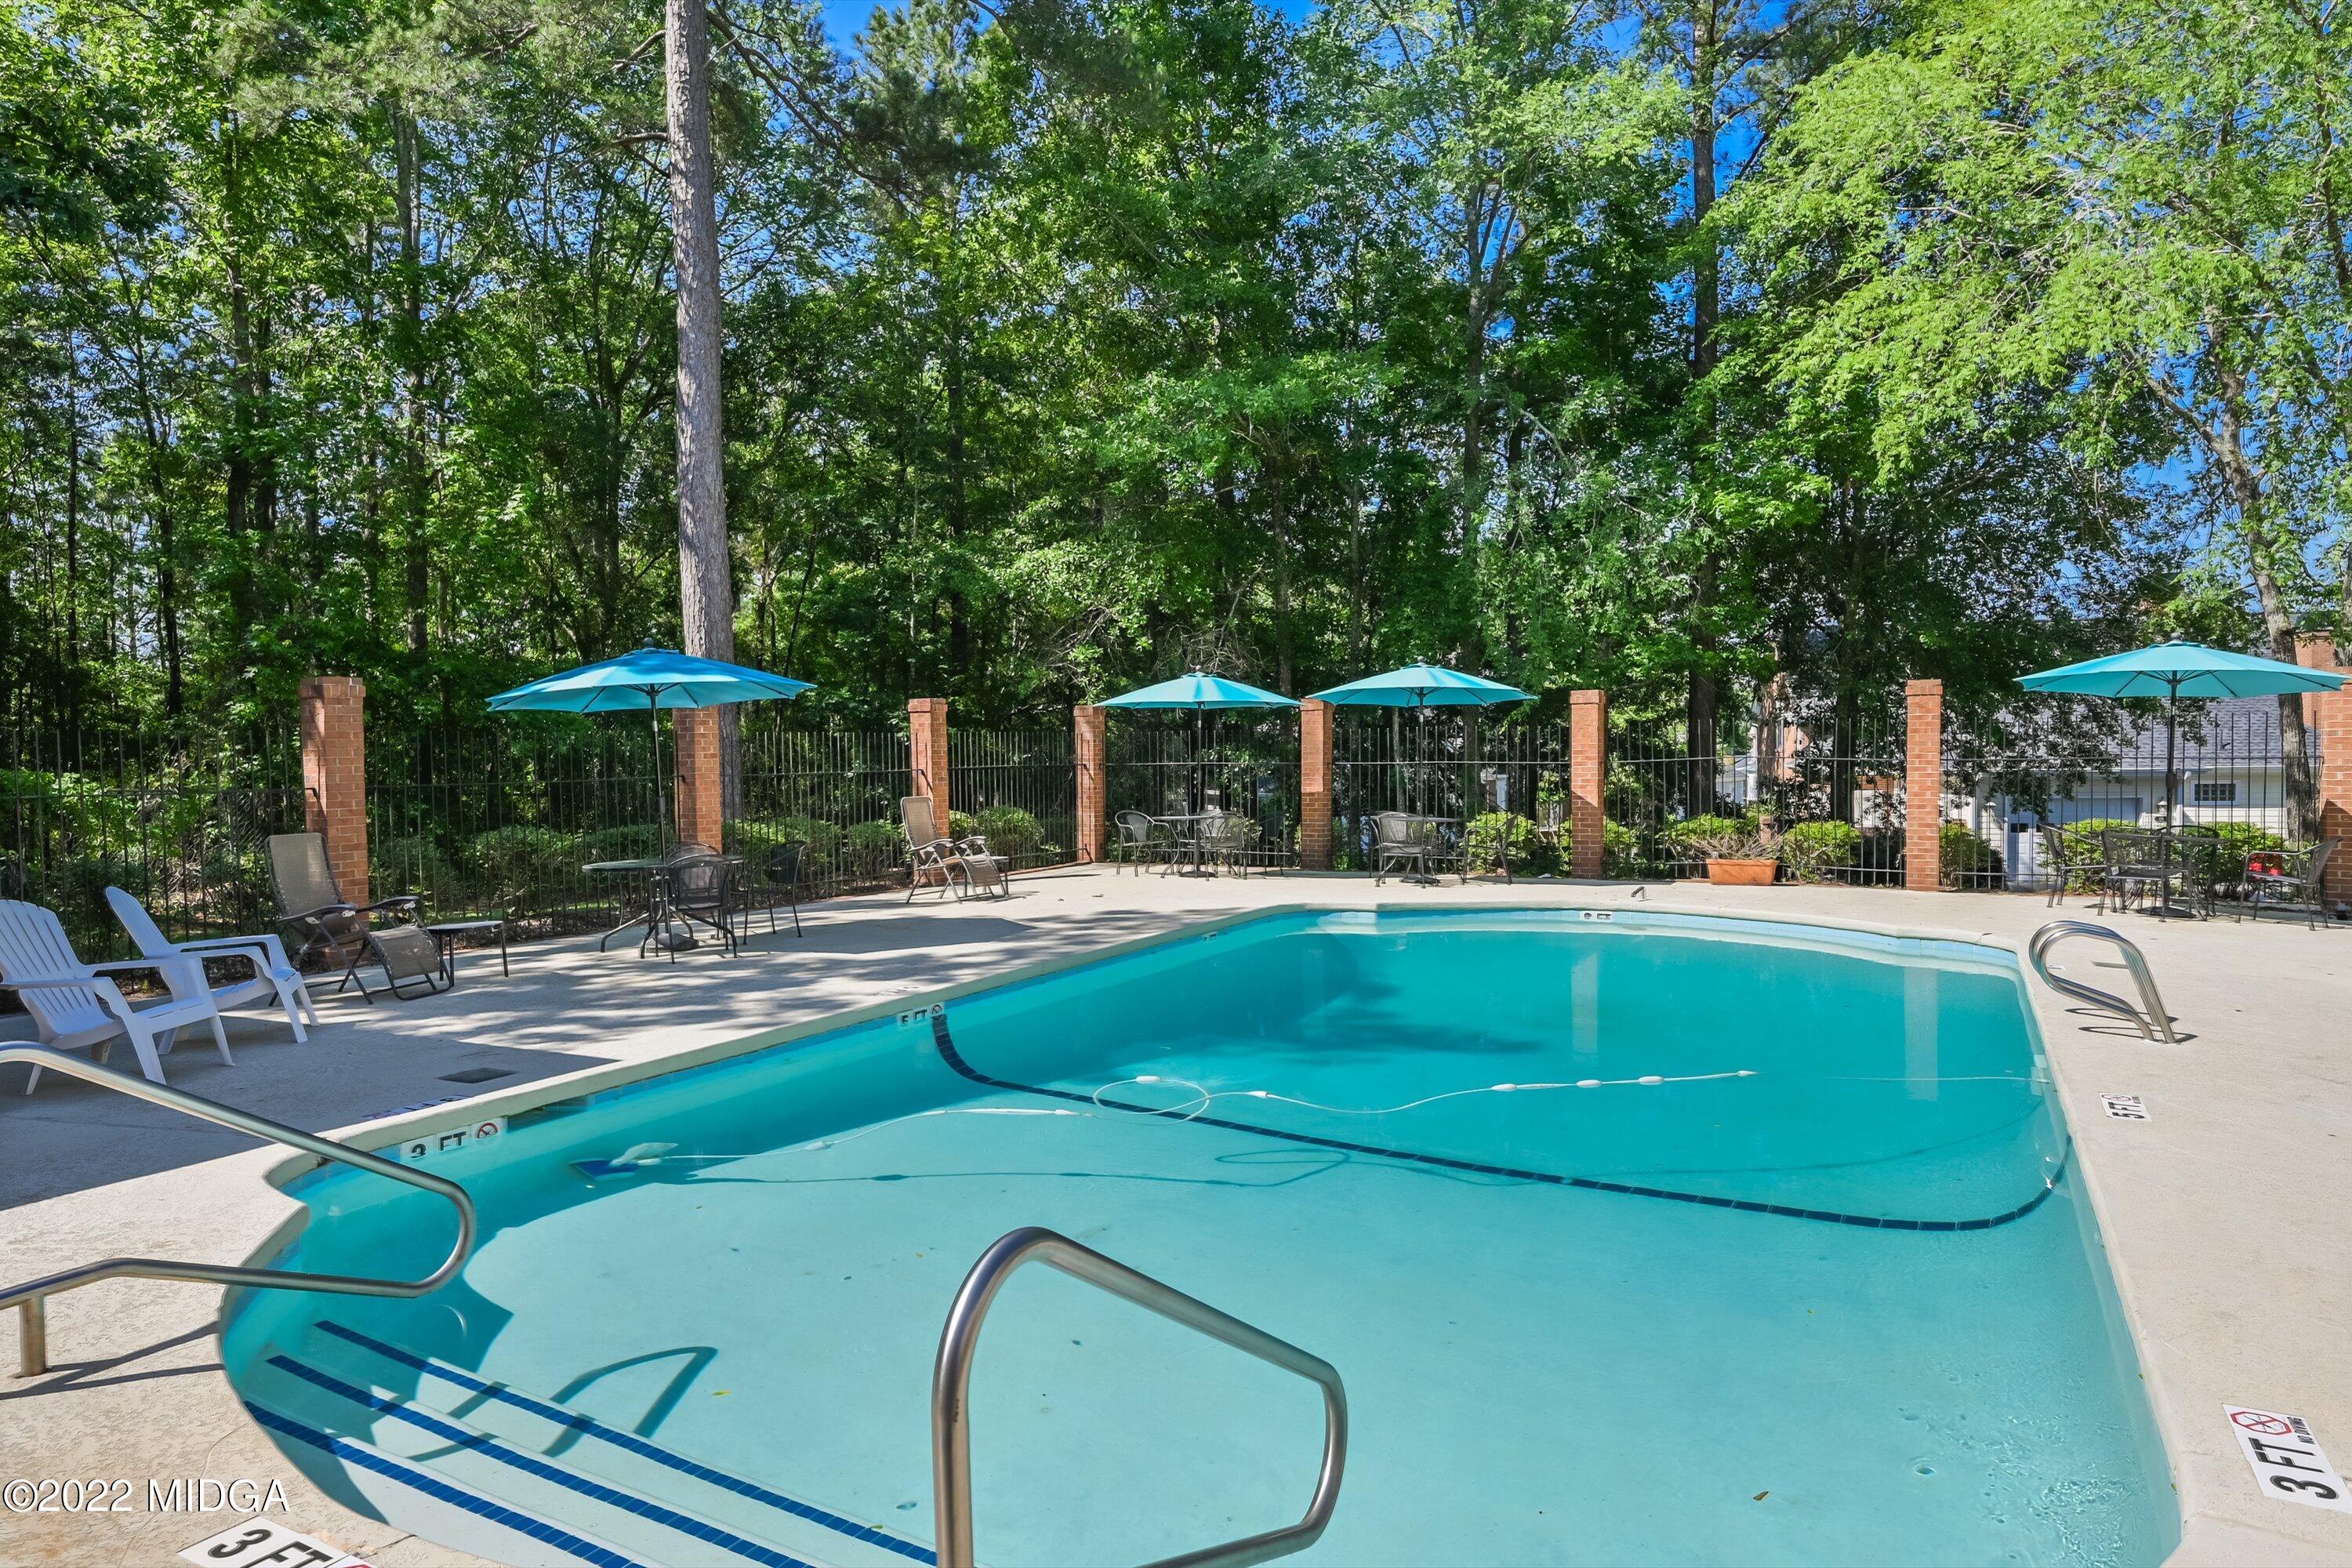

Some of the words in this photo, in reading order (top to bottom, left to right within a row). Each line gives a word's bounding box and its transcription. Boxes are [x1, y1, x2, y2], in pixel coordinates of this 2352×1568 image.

[2107, 1102, 2142, 1112] FT
[439, 1131, 466, 1151] FT
[2248, 1437, 2325, 1473] FT
[2270, 1475, 2339, 1500] 3
[207, 1529, 273, 1559] 3
